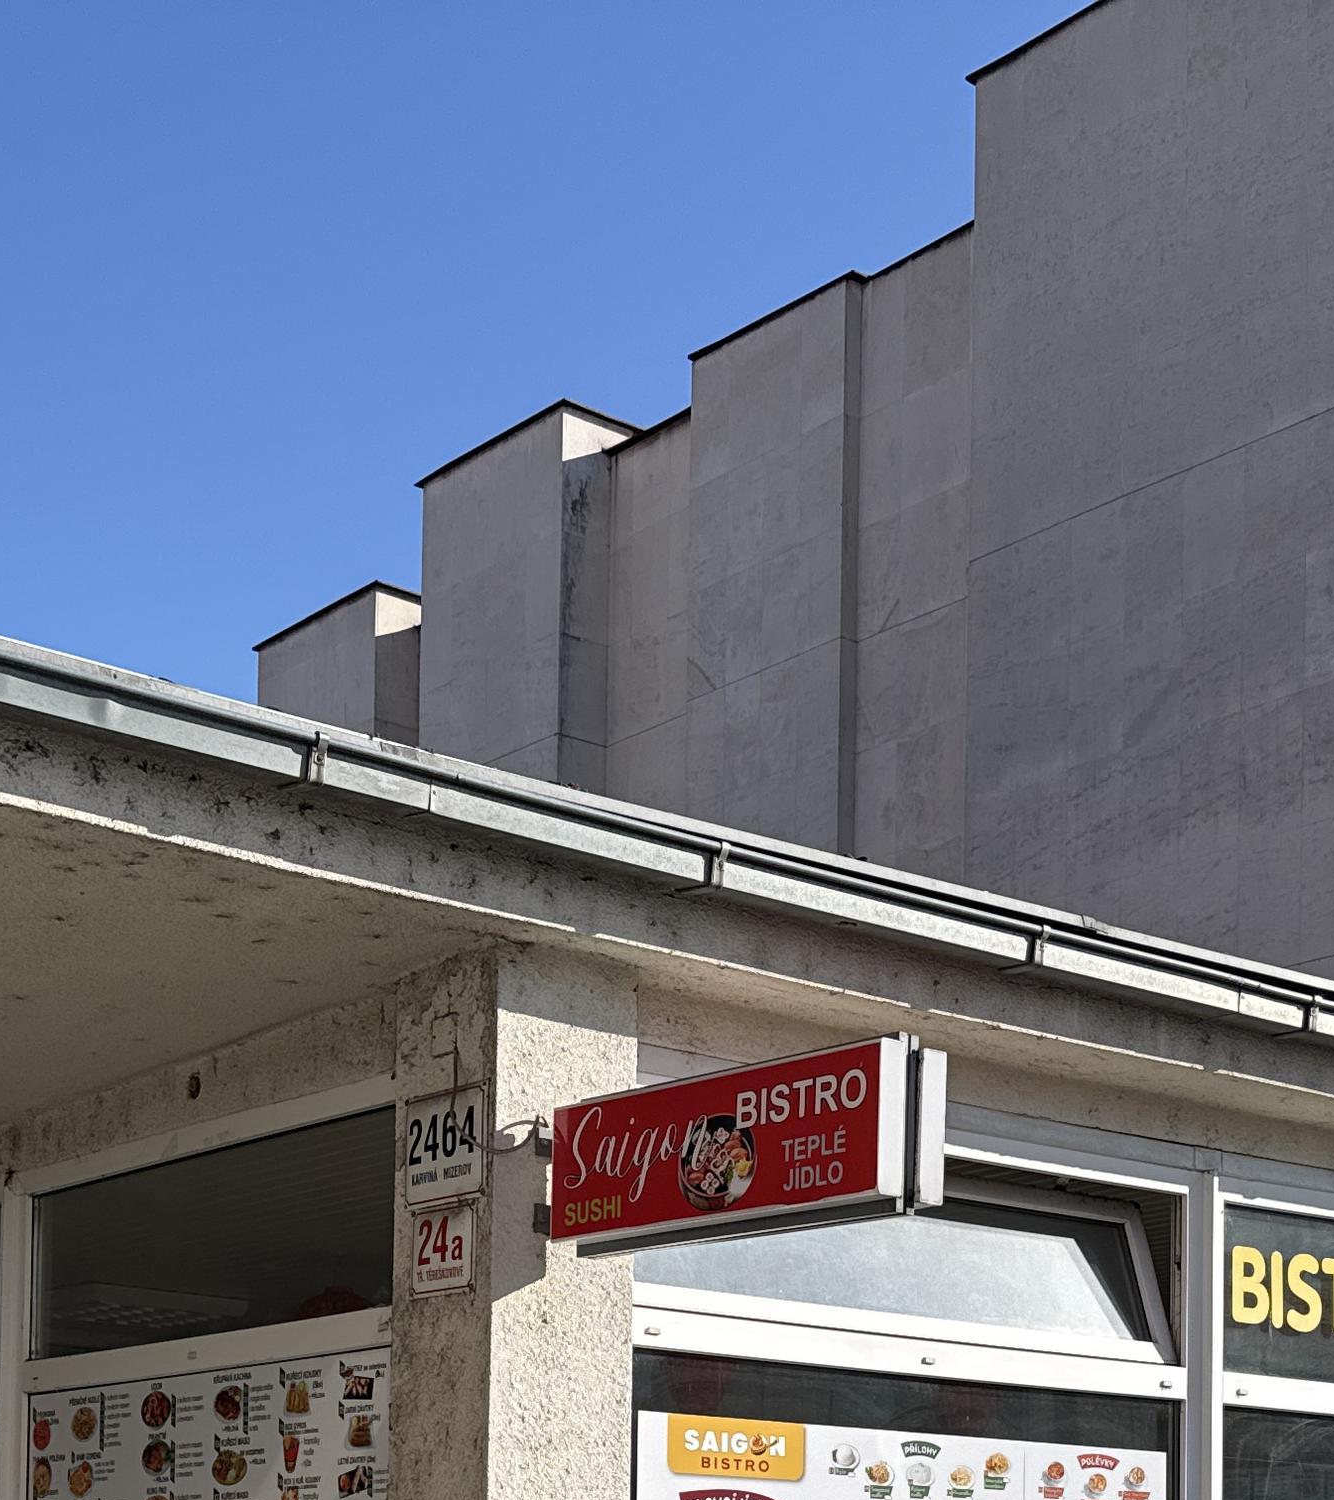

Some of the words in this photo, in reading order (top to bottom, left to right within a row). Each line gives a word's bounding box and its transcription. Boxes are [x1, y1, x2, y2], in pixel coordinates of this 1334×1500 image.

[735, 1067, 867, 1130] BISTRO
[408, 1105, 477, 1167] 2464
[781, 1125, 847, 1162] TEPLÉ
[563, 1105, 709, 1203] Saigon
[783, 1160, 844, 1192] JÍDLO
[565, 1194, 622, 1226] SUSHI
[417, 1215, 463, 1267] 24a
[700, 1456, 770, 1473] BISTRO
[904, 1442, 938, 1456] PŘÍLOHY
[1080, 1455, 1116, 1470] POLÉVKY
